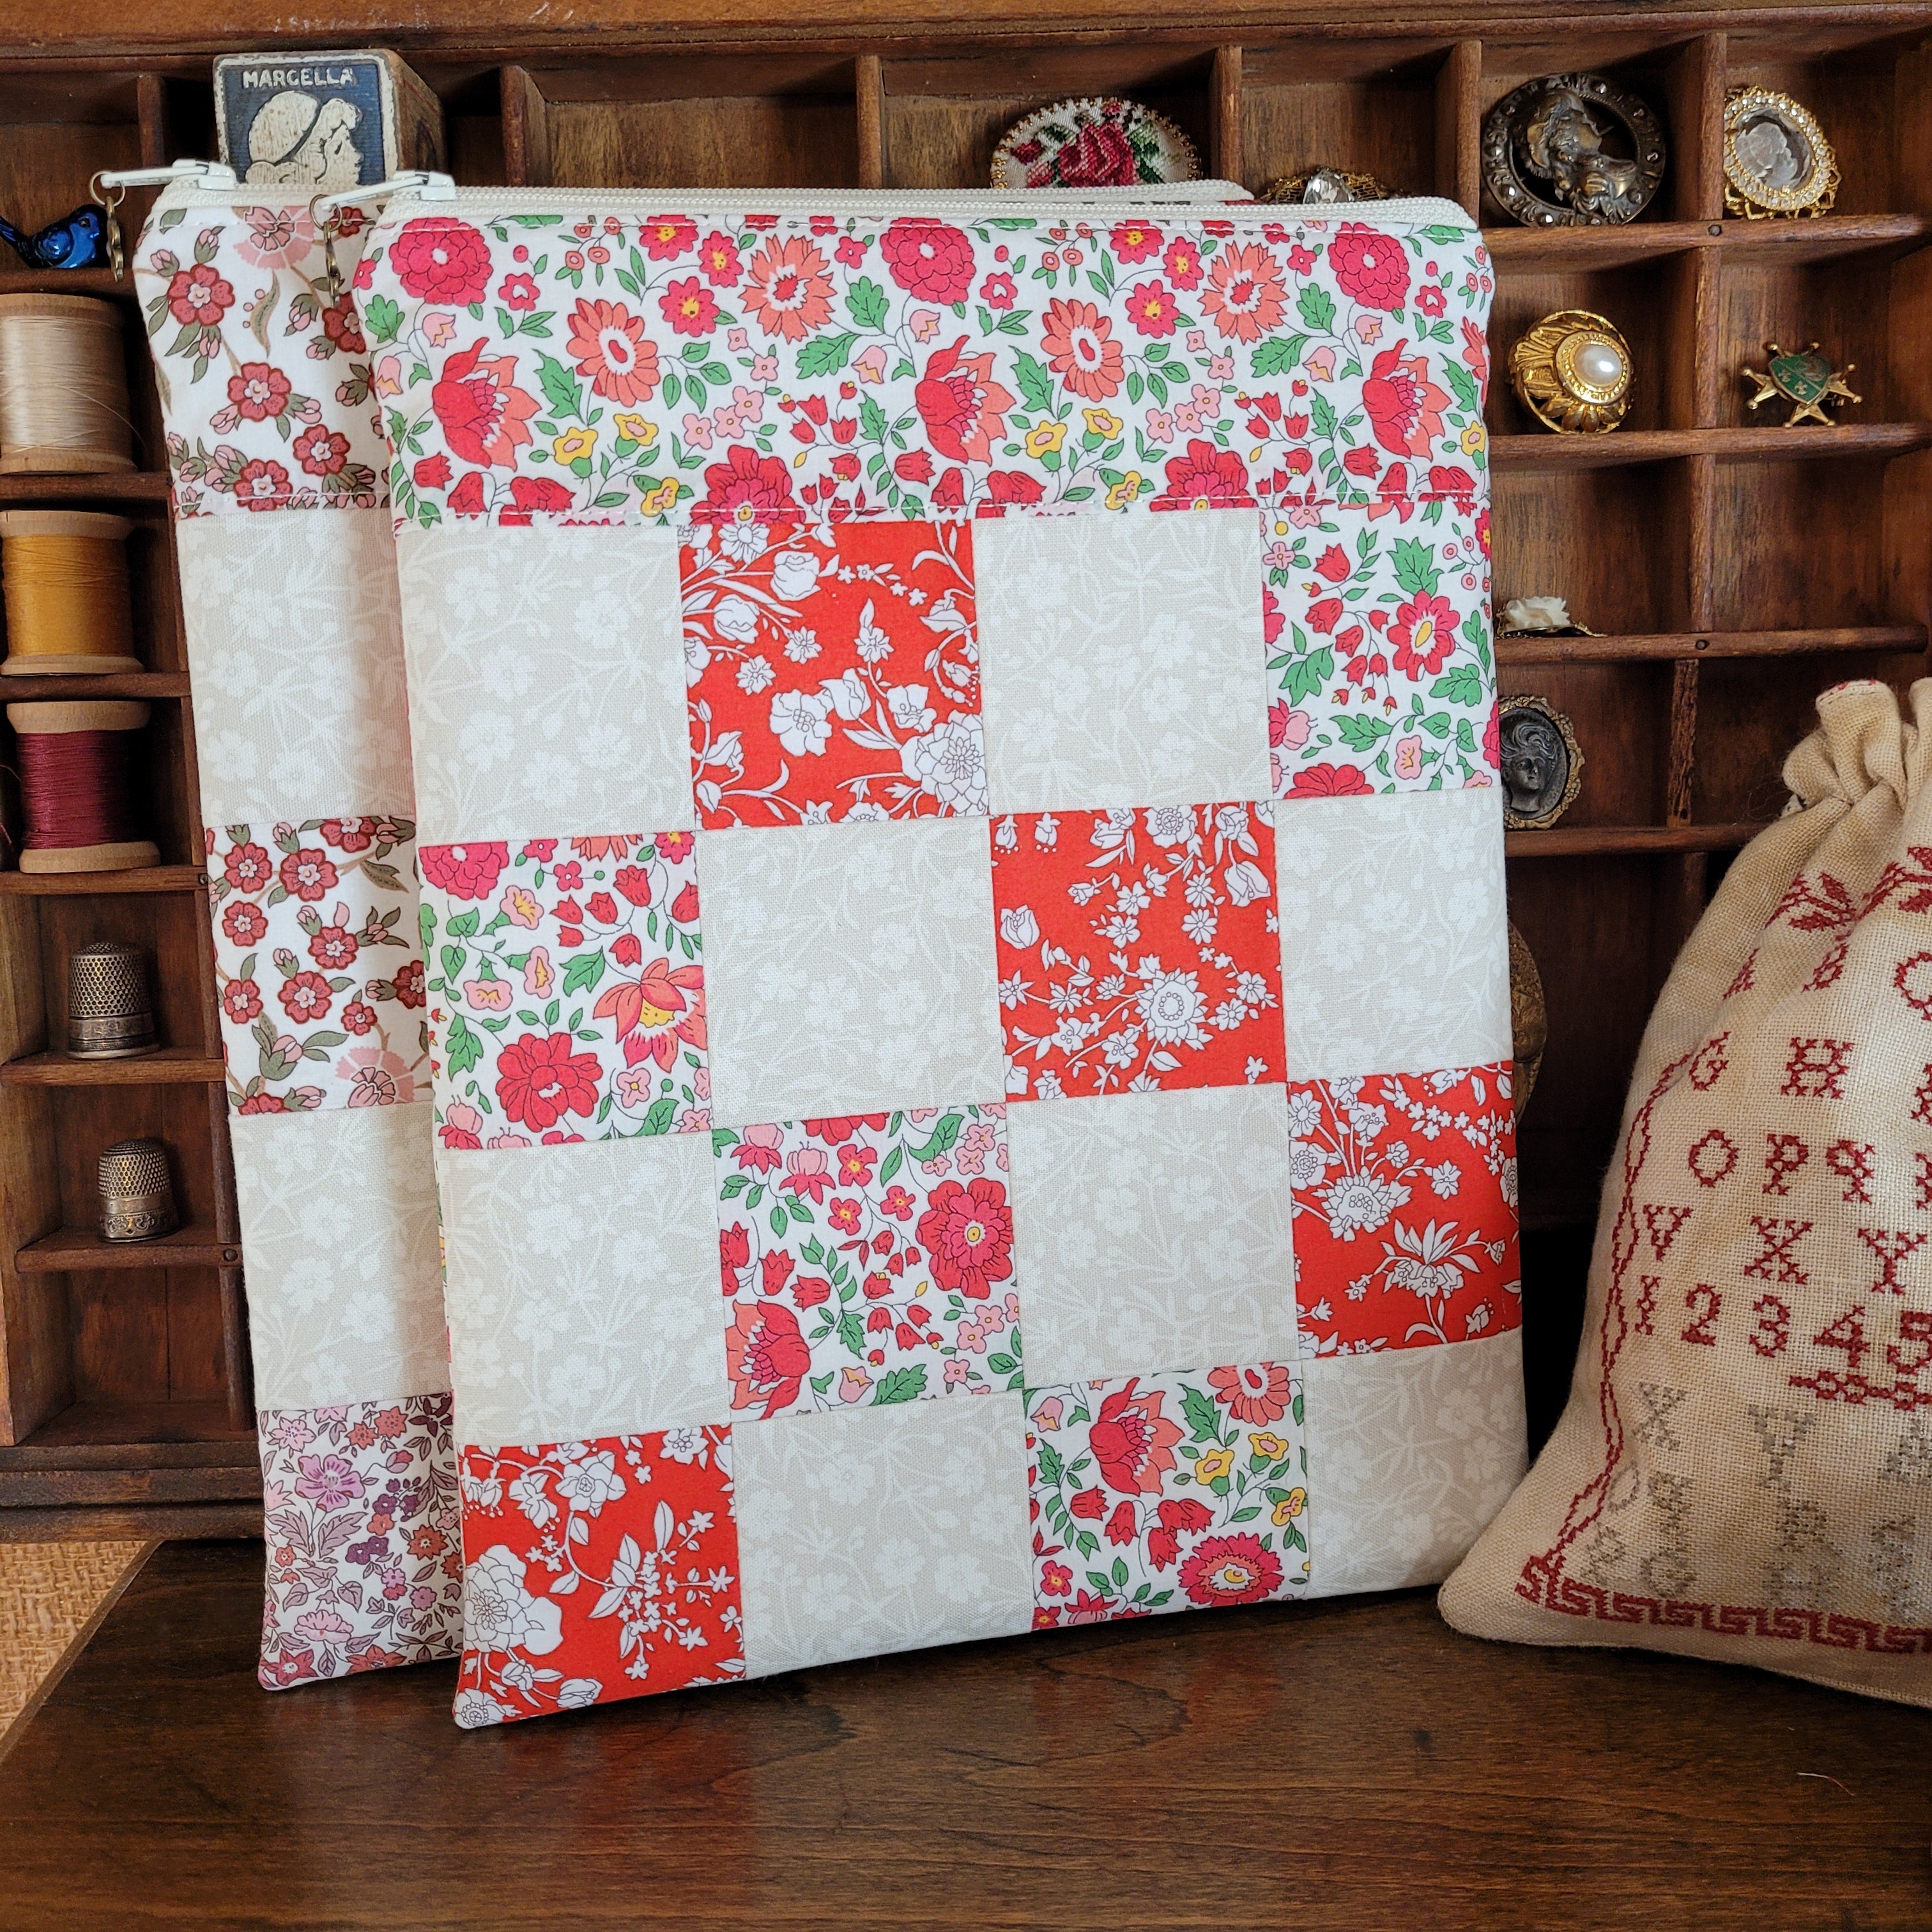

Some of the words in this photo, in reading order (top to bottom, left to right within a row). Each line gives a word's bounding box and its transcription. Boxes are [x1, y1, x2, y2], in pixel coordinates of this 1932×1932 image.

[242, 67, 355, 89] MARCELLA
[1781, 1037, 1853, 1098] H
[1744, 1216, 1813, 1285] X
[1858, 1229, 1926, 1295] Y
